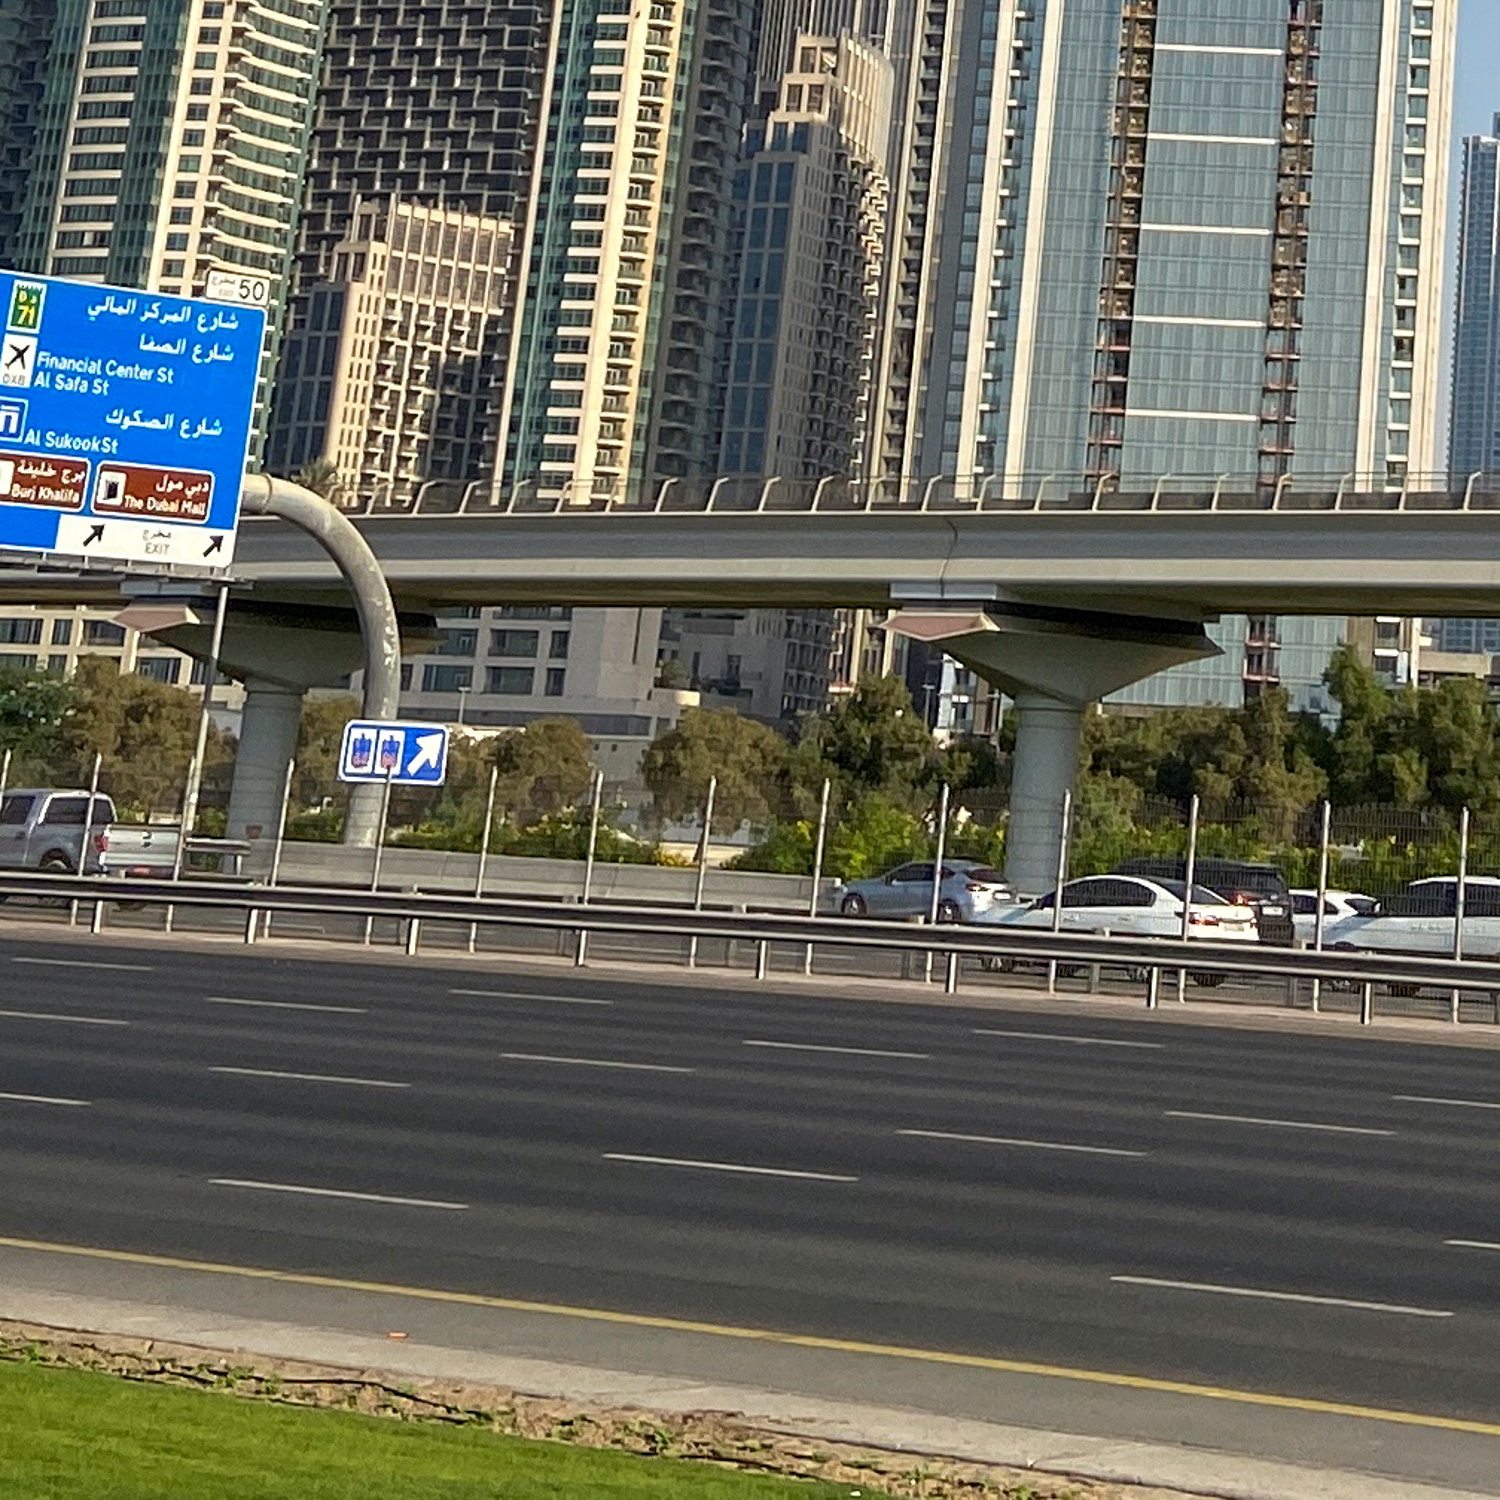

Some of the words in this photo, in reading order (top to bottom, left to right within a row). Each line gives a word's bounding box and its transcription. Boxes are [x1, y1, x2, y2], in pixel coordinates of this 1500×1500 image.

[238, 280, 265, 301] 50
[17, 304, 36, 326] 71
[87, 295, 137, 320] المالي
[140, 302, 191, 325] المركز
[196, 311, 239, 333] شارع
[139, 333, 186, 355] الصفا
[191, 343, 235, 364] شارع
[36, 351, 102, 376] Financial
[105, 359, 154, 381] Center
[157, 366, 174, 384] St
[33, 371, 50, 389] Al
[54, 375, 89, 393] Safa
[92, 378, 110, 396] St
[105, 407, 175, 431] الصكوك
[179, 417, 223, 439] شارع
[23, 430, 41, 446] Al
[44, 431, 101, 452] Sukook
[101, 436, 119, 454] St
[17, 459, 57, 477] خليفة
[11, 483, 36, 500] Burj
[38, 486, 80, 503] Khalifa
[155, 474, 183, 493] مول
[184, 479, 209, 499] دبي
[124, 494, 144, 509] The
[146, 496, 179, 513] Dubai
[180, 500, 206, 516] Mall
[144, 543, 171, 556] EXIT
